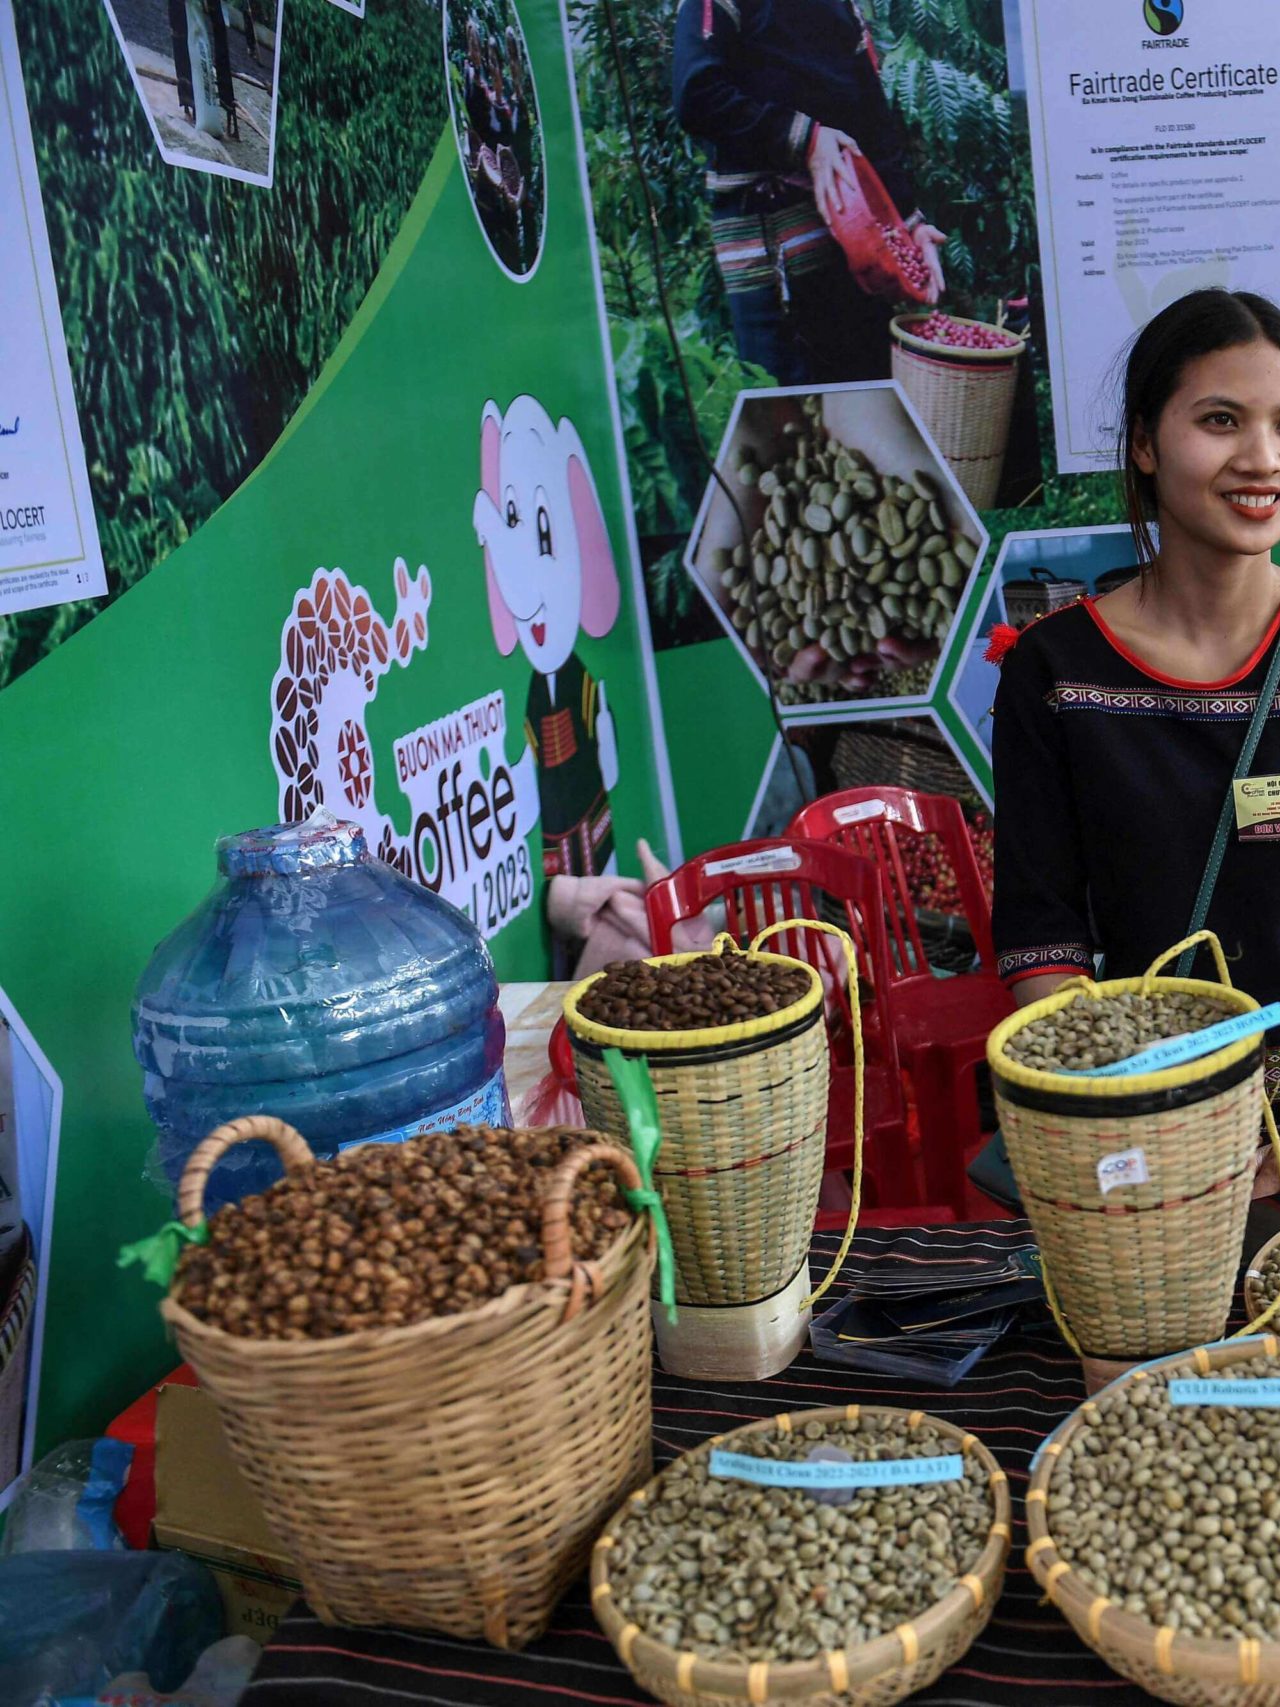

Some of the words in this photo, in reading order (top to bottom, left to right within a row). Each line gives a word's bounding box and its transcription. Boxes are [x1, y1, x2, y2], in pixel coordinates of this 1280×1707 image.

[1142, 38, 1190, 50] FAIRTRADE
[1070, 68, 1165, 96] Fairtrade
[1170, 63, 1279, 91] Certificate
[1139, 92, 1175, 102] Sustainable
[1176, 91, 1195, 100] Coffee
[1197, 89, 1228, 100] Producing
[1228, 88, 1264, 97] Cooperative
[1105, 145, 1139, 154] compliance
[1141, 143, 1154, 151] with
[1166, 141, 1194, 150] Fairtrade
[1195, 139, 1225, 148] standards
[1226, 138, 1238, 147] and
[1239, 137, 1266, 146] FLOCERT
[1110, 153, 1146, 162] certification
[1147, 151, 1188, 161] requirements
[1209, 148, 1228, 157] below
[0, 506, 46, 531] LOCERT
[397, 728, 441, 783] BUON
[439, 718, 465, 755] MA
[464, 698, 505, 746] THUOT
[484, 845, 532, 929] 2023
